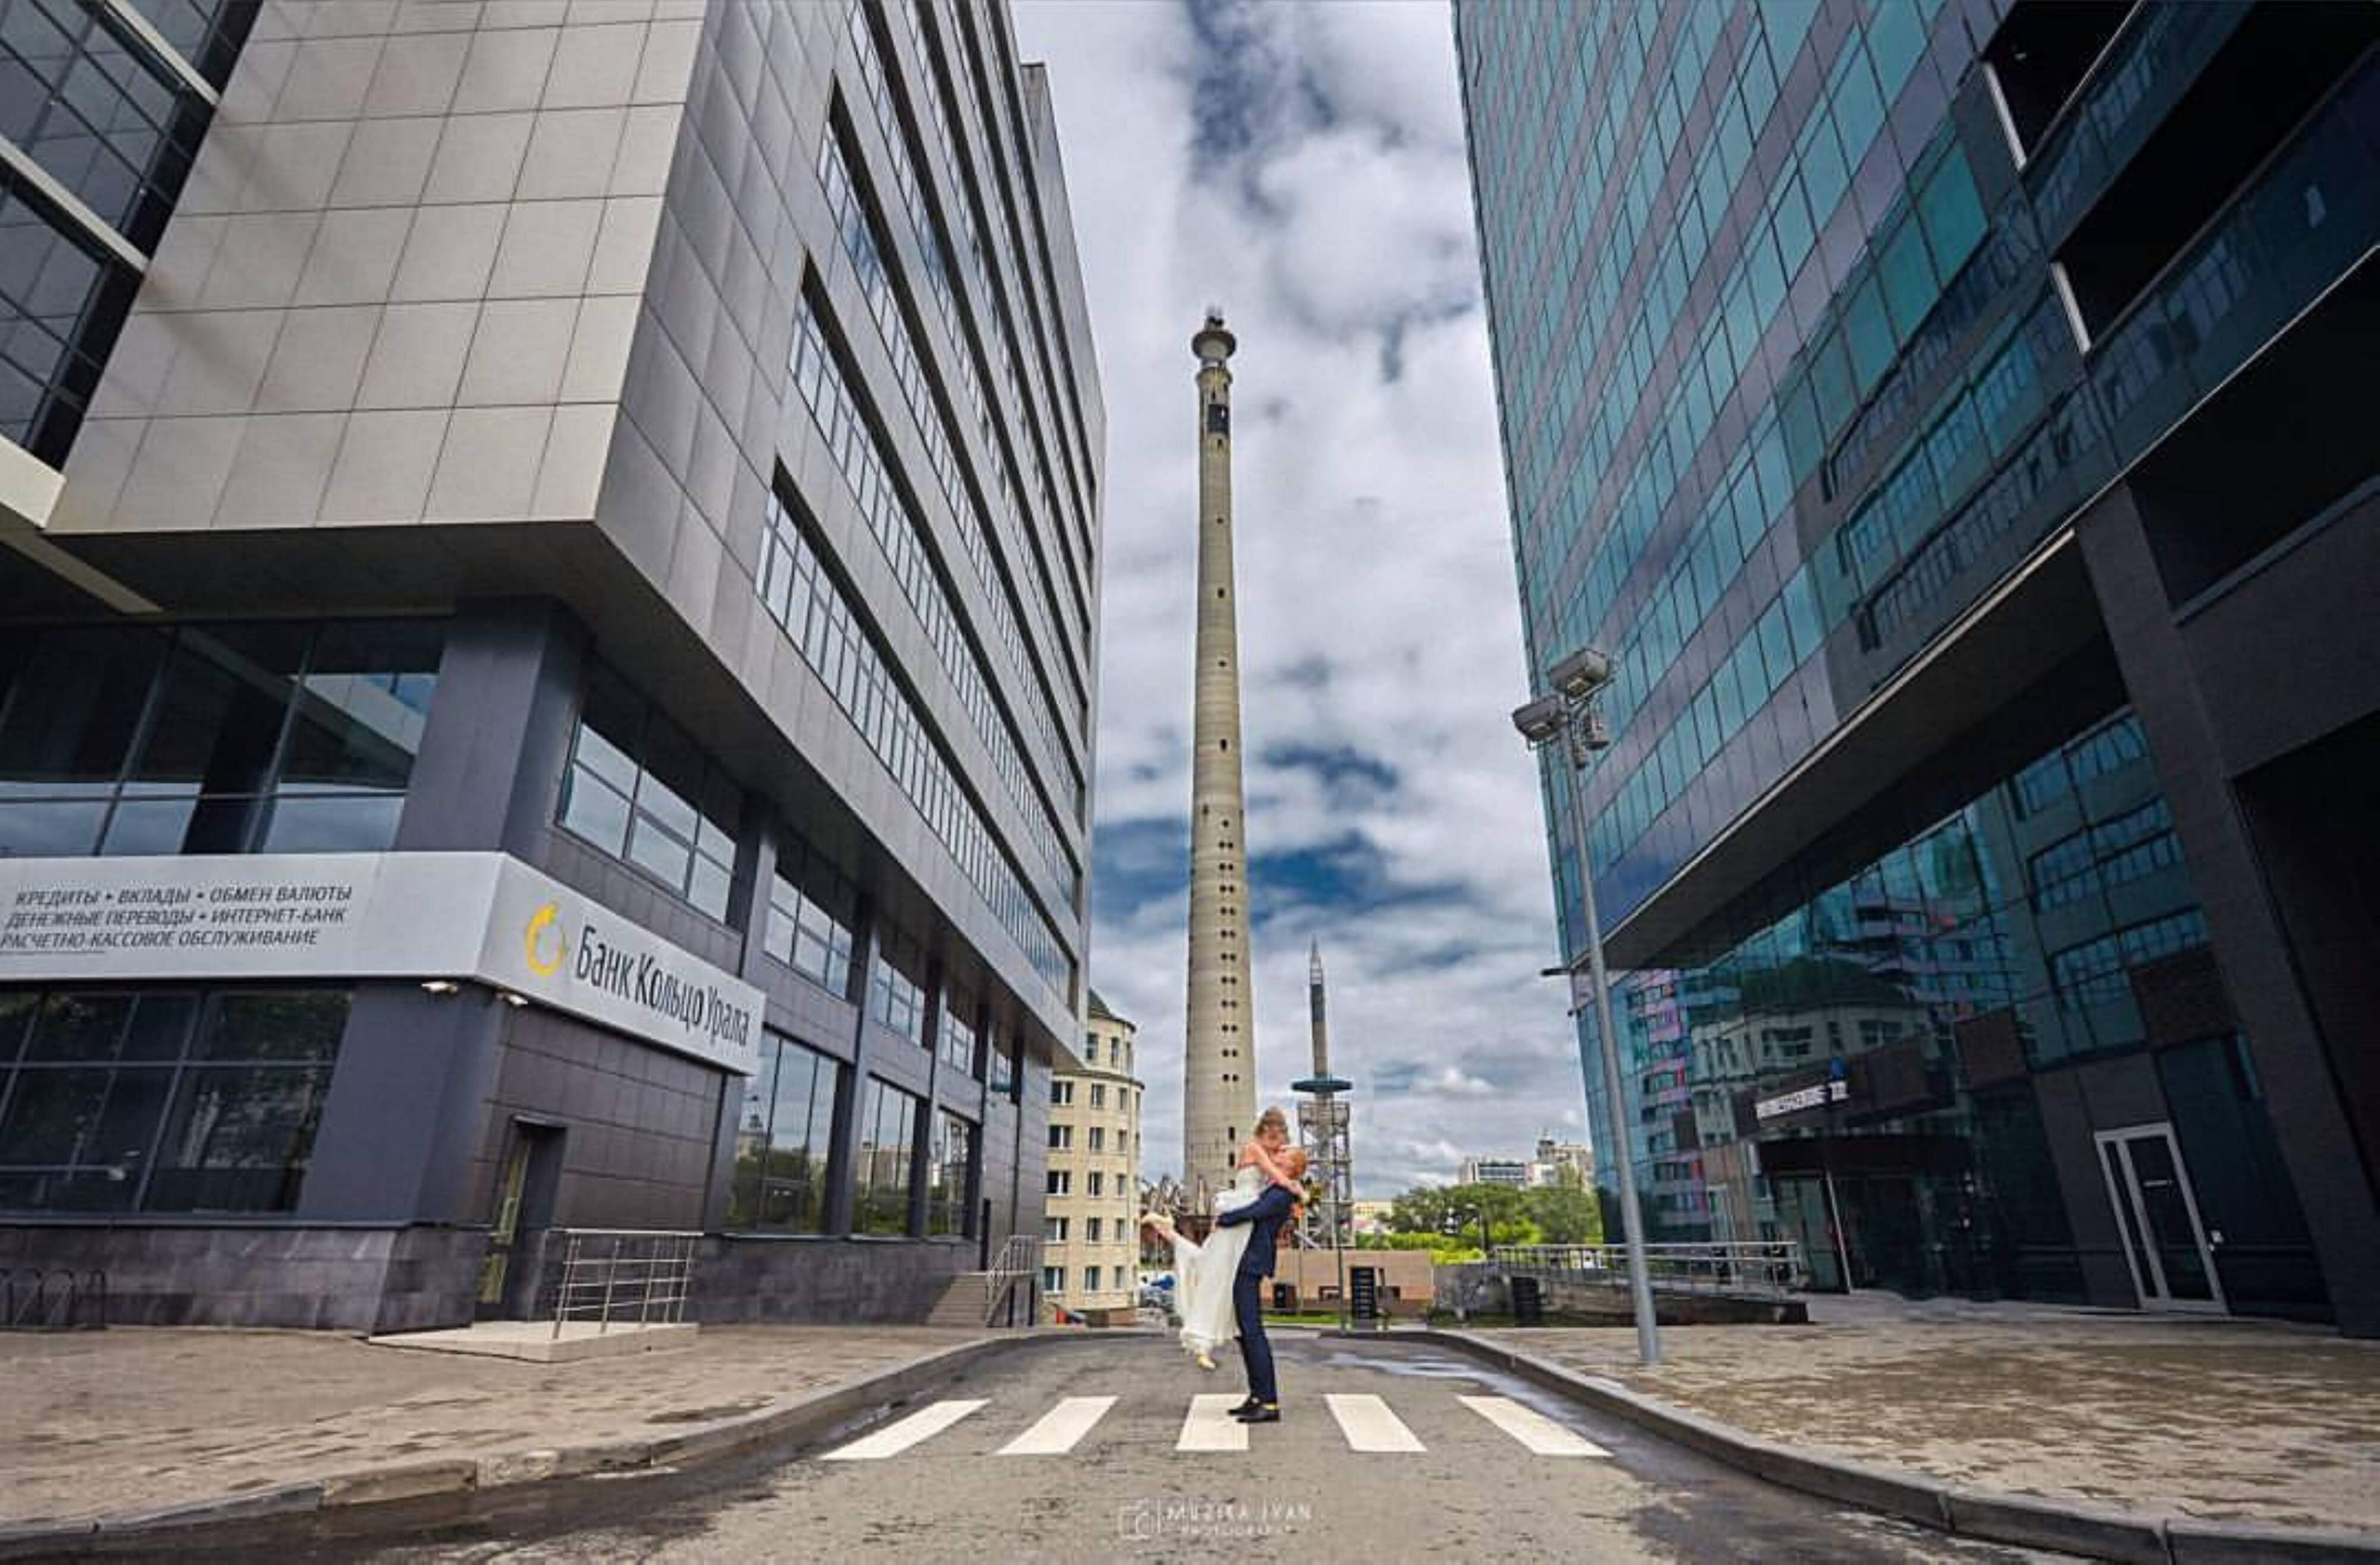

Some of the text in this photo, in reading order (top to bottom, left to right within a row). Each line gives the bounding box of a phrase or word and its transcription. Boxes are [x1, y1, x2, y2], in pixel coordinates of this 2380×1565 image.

[16, 885, 352, 908] КРЕДИТЫ ВКЛАДЫ ОБМЕН ВАЛЮТЫ
[6, 908, 350, 930] ДЕНЕЖНЫЕ ПЕРЕВОДЫ ИНТЕРНЕТ-БАНК
[178, 930, 321, 947] ОБСЛУЖИВАНИЕ
[575, 924, 750, 1047] Банк Кольцо Урала
